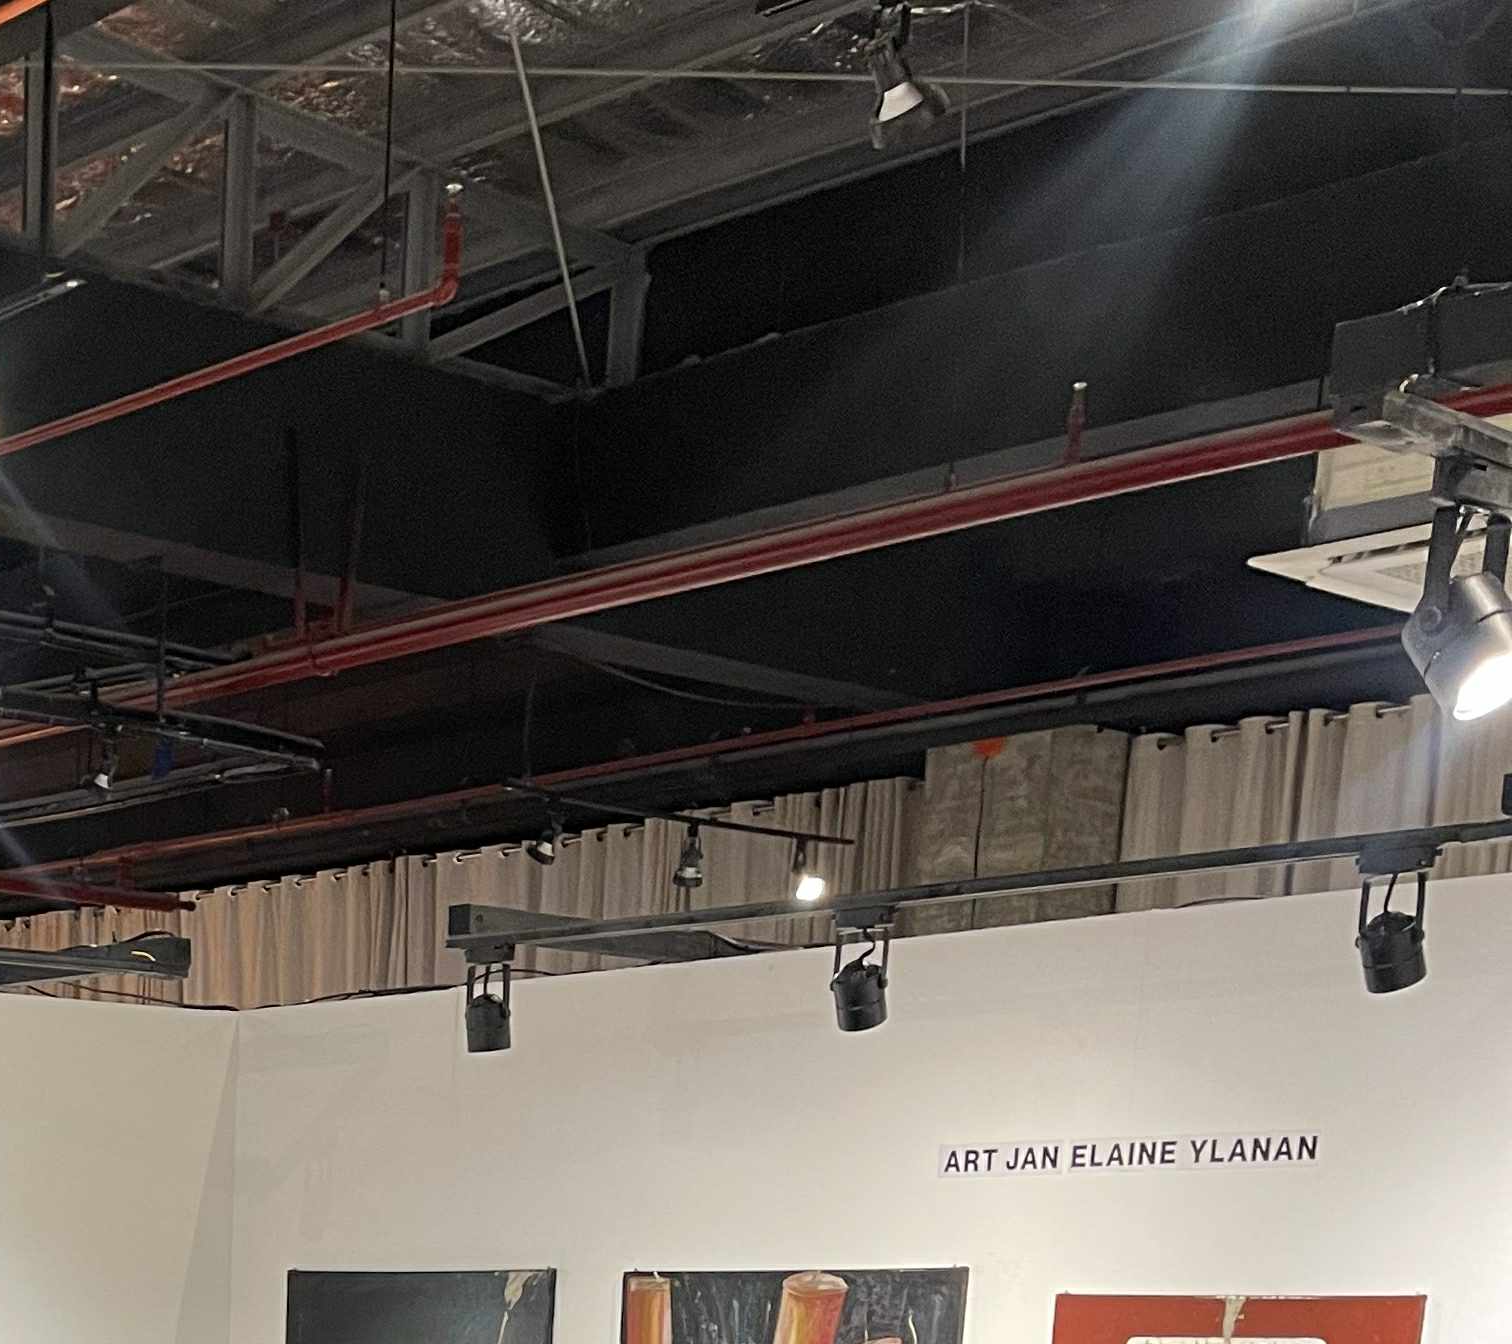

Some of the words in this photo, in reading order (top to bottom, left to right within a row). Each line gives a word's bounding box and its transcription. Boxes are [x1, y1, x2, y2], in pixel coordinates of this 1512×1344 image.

[944, 1148, 998, 1173] ART
[1006, 1146, 1059, 1170] JAN
[1071, 1141, 1177, 1168] ELAINE
[1190, 1135, 1318, 1163] YLANAN
